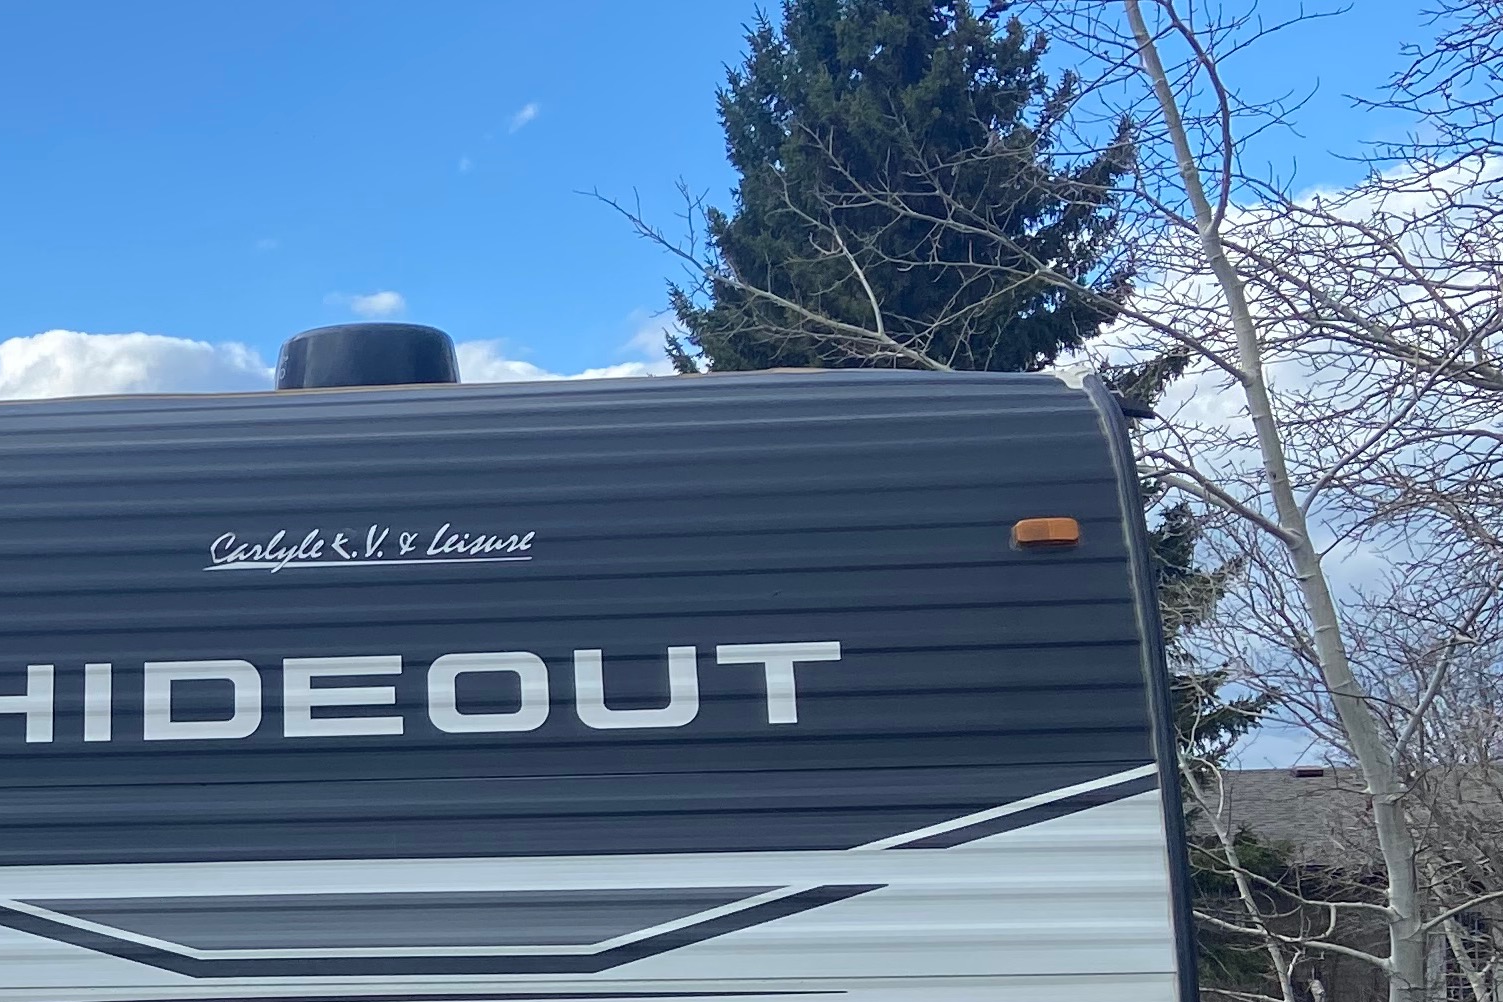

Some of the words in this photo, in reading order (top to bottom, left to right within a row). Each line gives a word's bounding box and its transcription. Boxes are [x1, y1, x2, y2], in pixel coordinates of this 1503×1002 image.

[211, 529, 322, 572] Carlyle
[400, 532, 417, 551] &
[427, 523, 535, 555] Leisure
